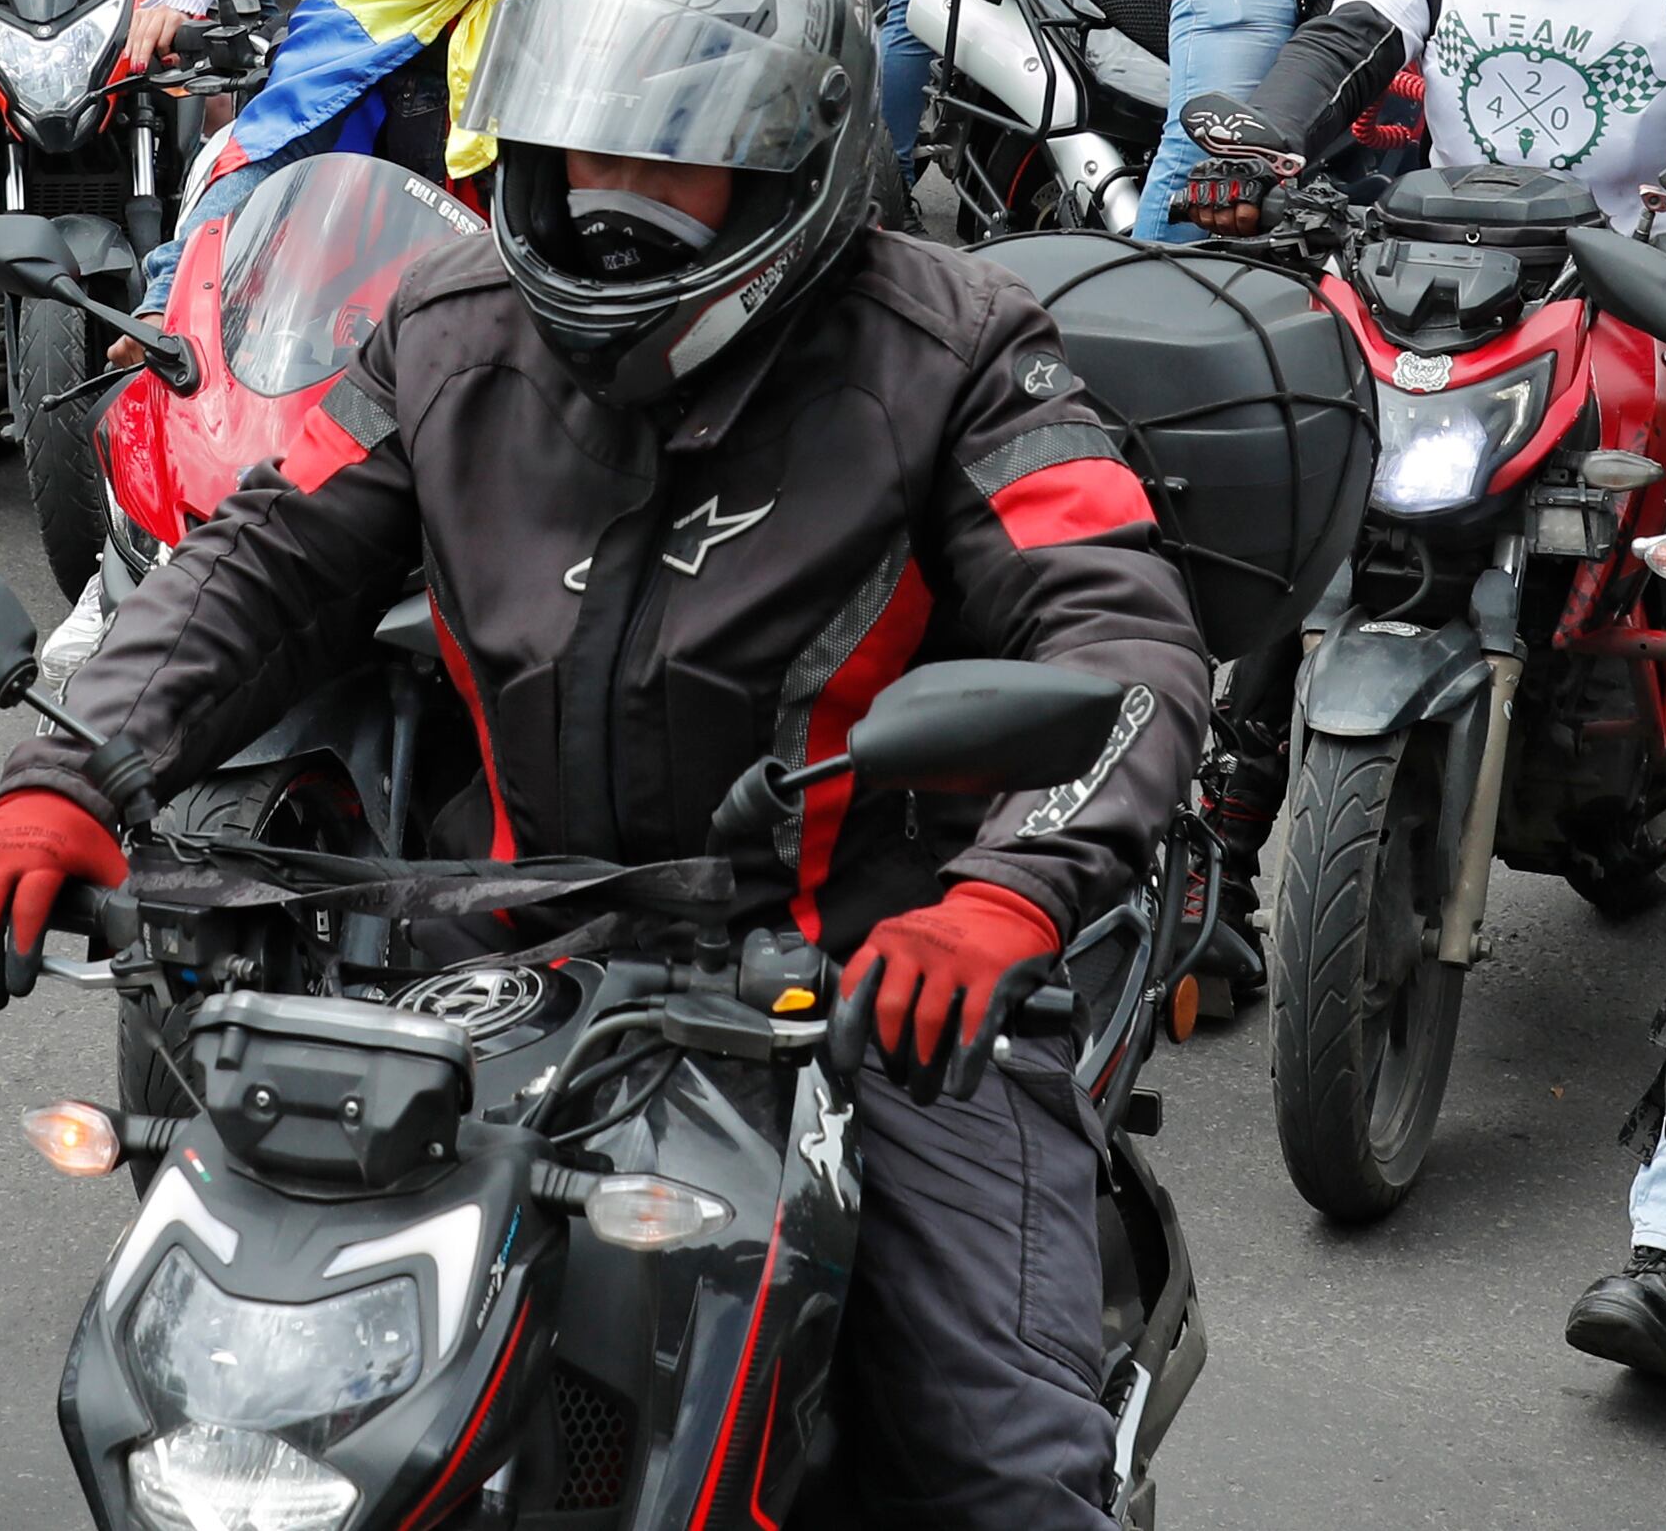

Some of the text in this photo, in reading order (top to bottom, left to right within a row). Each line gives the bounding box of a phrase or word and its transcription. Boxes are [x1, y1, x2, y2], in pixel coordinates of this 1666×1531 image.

[1482, 12, 1594, 53] TEAM
[404, 176, 480, 237] FULL GASS
